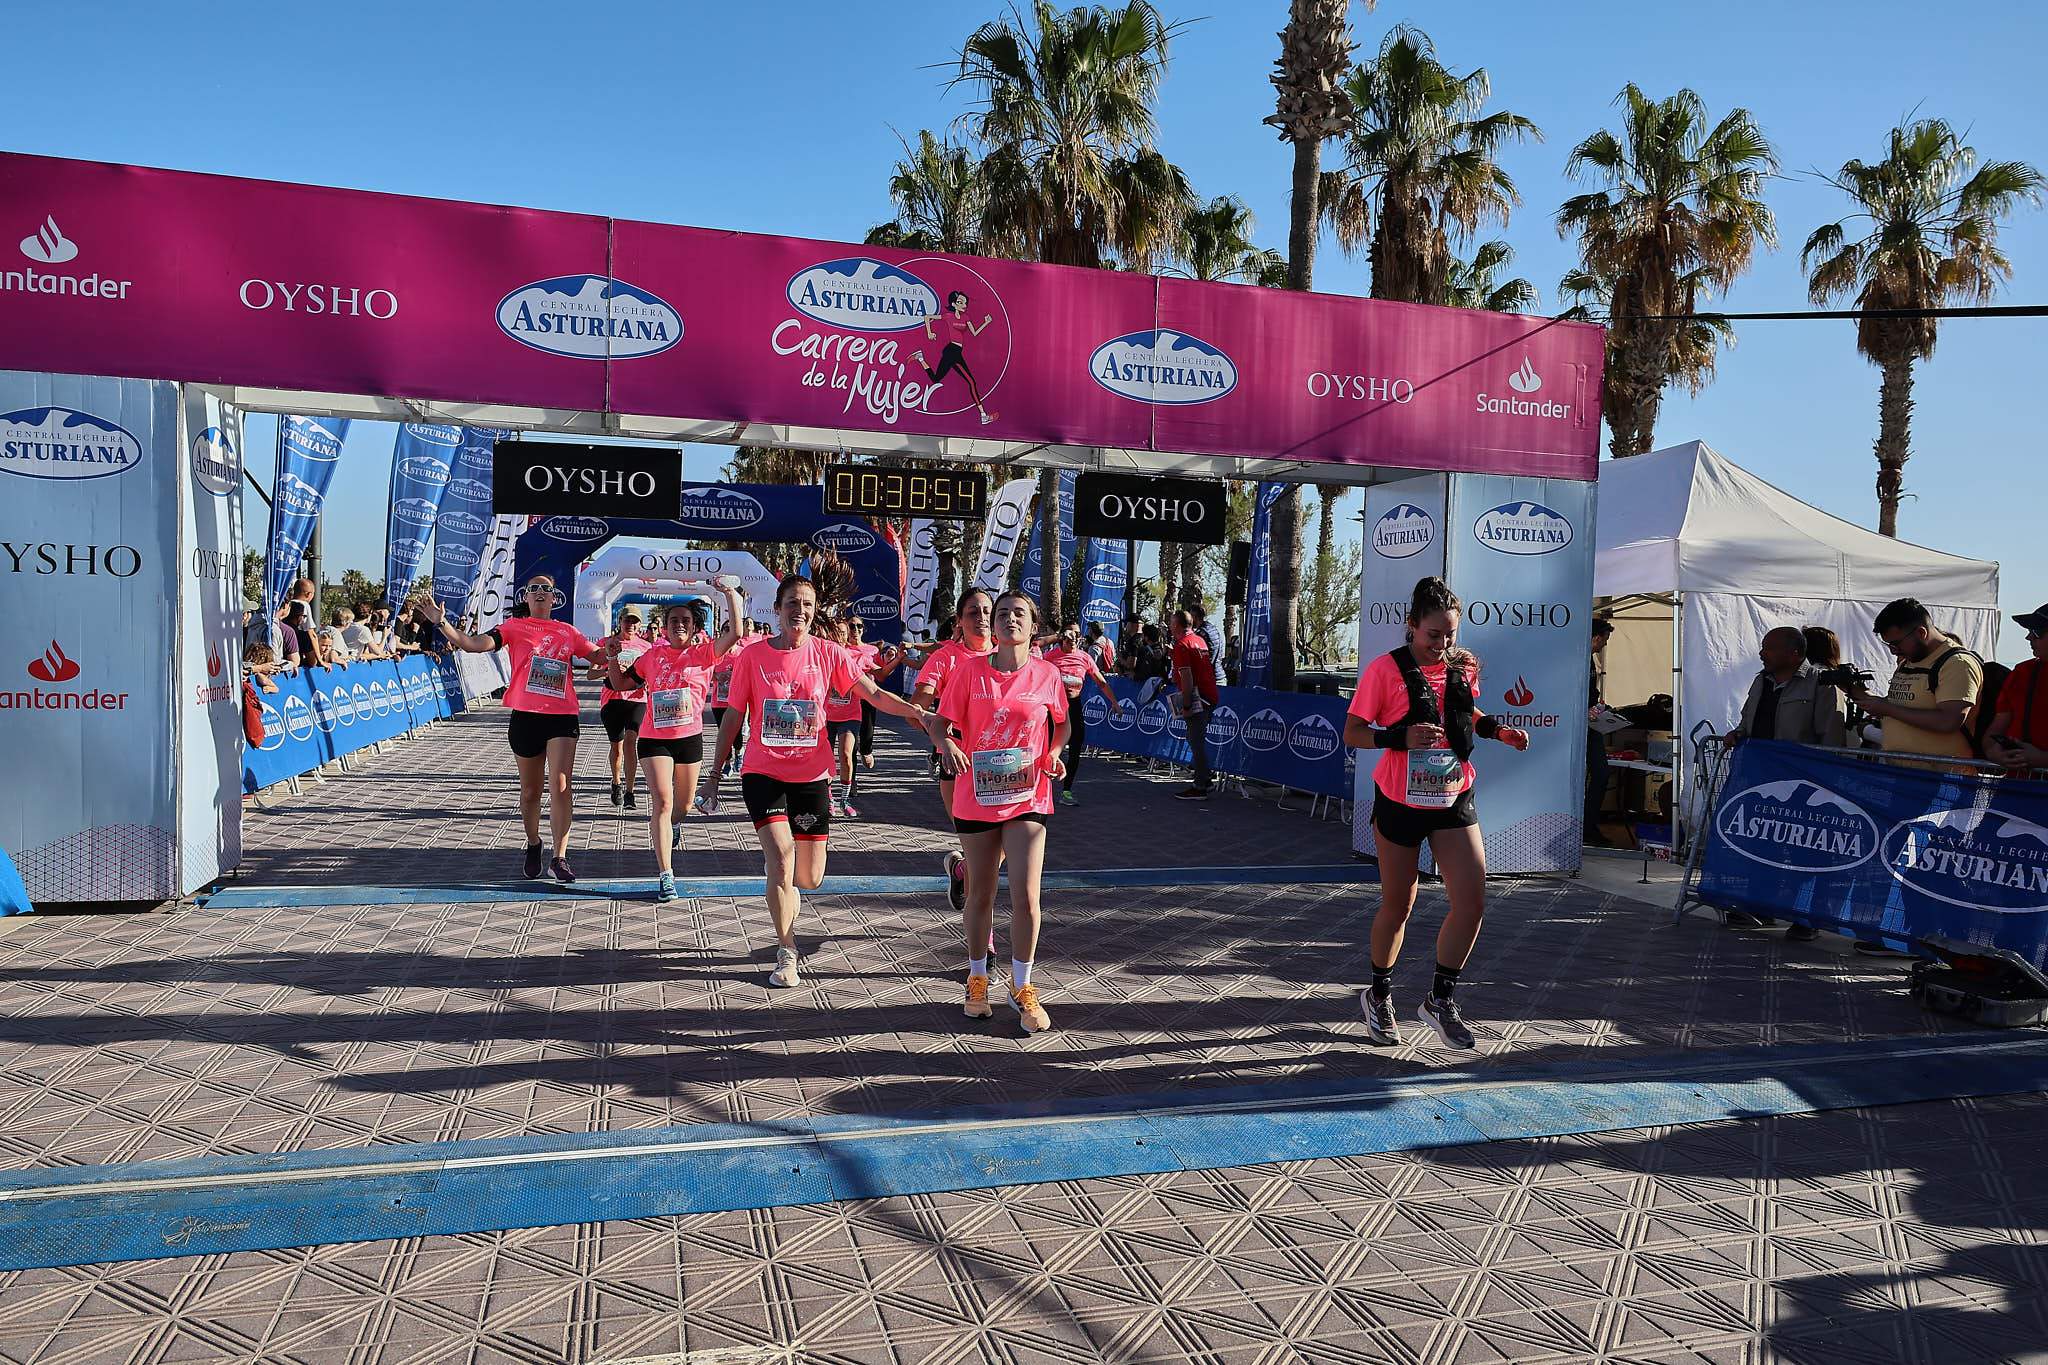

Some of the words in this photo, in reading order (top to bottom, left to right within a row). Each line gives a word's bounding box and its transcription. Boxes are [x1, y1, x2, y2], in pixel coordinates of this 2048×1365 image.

[0, 267, 131, 300] ntander
[822, 278, 872, 291] CENTRAL
[875, 283, 925, 296] LECHERA
[239, 279, 398, 319] OYSHO
[540, 300, 599, 313] CENTRAL
[604, 305, 664, 318] LECHERA
[799, 278, 929, 318] ASTURIANA
[510, 300, 670, 342] ASTURIANA
[771, 319, 898, 366] Carrera
[1101, 350, 1226, 391] ASTURIANA
[1123, 352, 1169, 364] CENTRAL
[1173, 356, 1223, 368] LECHERA
[801, 361, 826, 389] de
[829, 371, 849, 391] la
[843, 363, 944, 425] Mujer
[1307, 371, 1415, 404] OYSHO
[1476, 393, 1571, 420] Santander
[6, 429, 63, 441] CENTRAL
[68, 432, 124, 444] LECHERA
[282, 428, 337, 457] STURIANA
[0, 441, 129, 465] STURIANA
[524, 464, 656, 498] OYSHO
[836, 472, 975, 511] 00:38:54
[681, 504, 756, 521] STURIANA
[1099, 494, 1205, 524] OYSHO
[441, 516, 482, 532] ASTURIANA
[546, 520, 604, 536] ASTURIANA
[1480, 519, 1566, 544] ASTURIANA
[1496, 518, 1528, 526] CENTRAL
[1530, 520, 1564, 528] LECHERA
[817, 533, 872, 547] ASTURIANA
[979, 500, 1022, 592] YSHO
[1376, 527, 1430, 547] ASTURIANA
[1, 542, 142, 577] YSHO
[192, 547, 238, 581] OYSHO
[639, 554, 722, 573] OYSHO
[588, 570, 615, 578] OYSHO
[906, 527, 936, 635] OYSHO
[854, 601, 898, 615] ASTURIANA
[1370, 602, 1410, 625] OYSH
[1467, 601, 1571, 628] OYSHO
[0, 687, 129, 711] antander
[1243, 722, 1282, 743] ASTURIANA
[1290, 729, 1332, 751] ASTURIANA
[1753, 803, 1803, 819] CENTRAL
[1807, 812, 1863, 830] LECHERA
[1725, 803, 1862, 858] ASTURIANA
